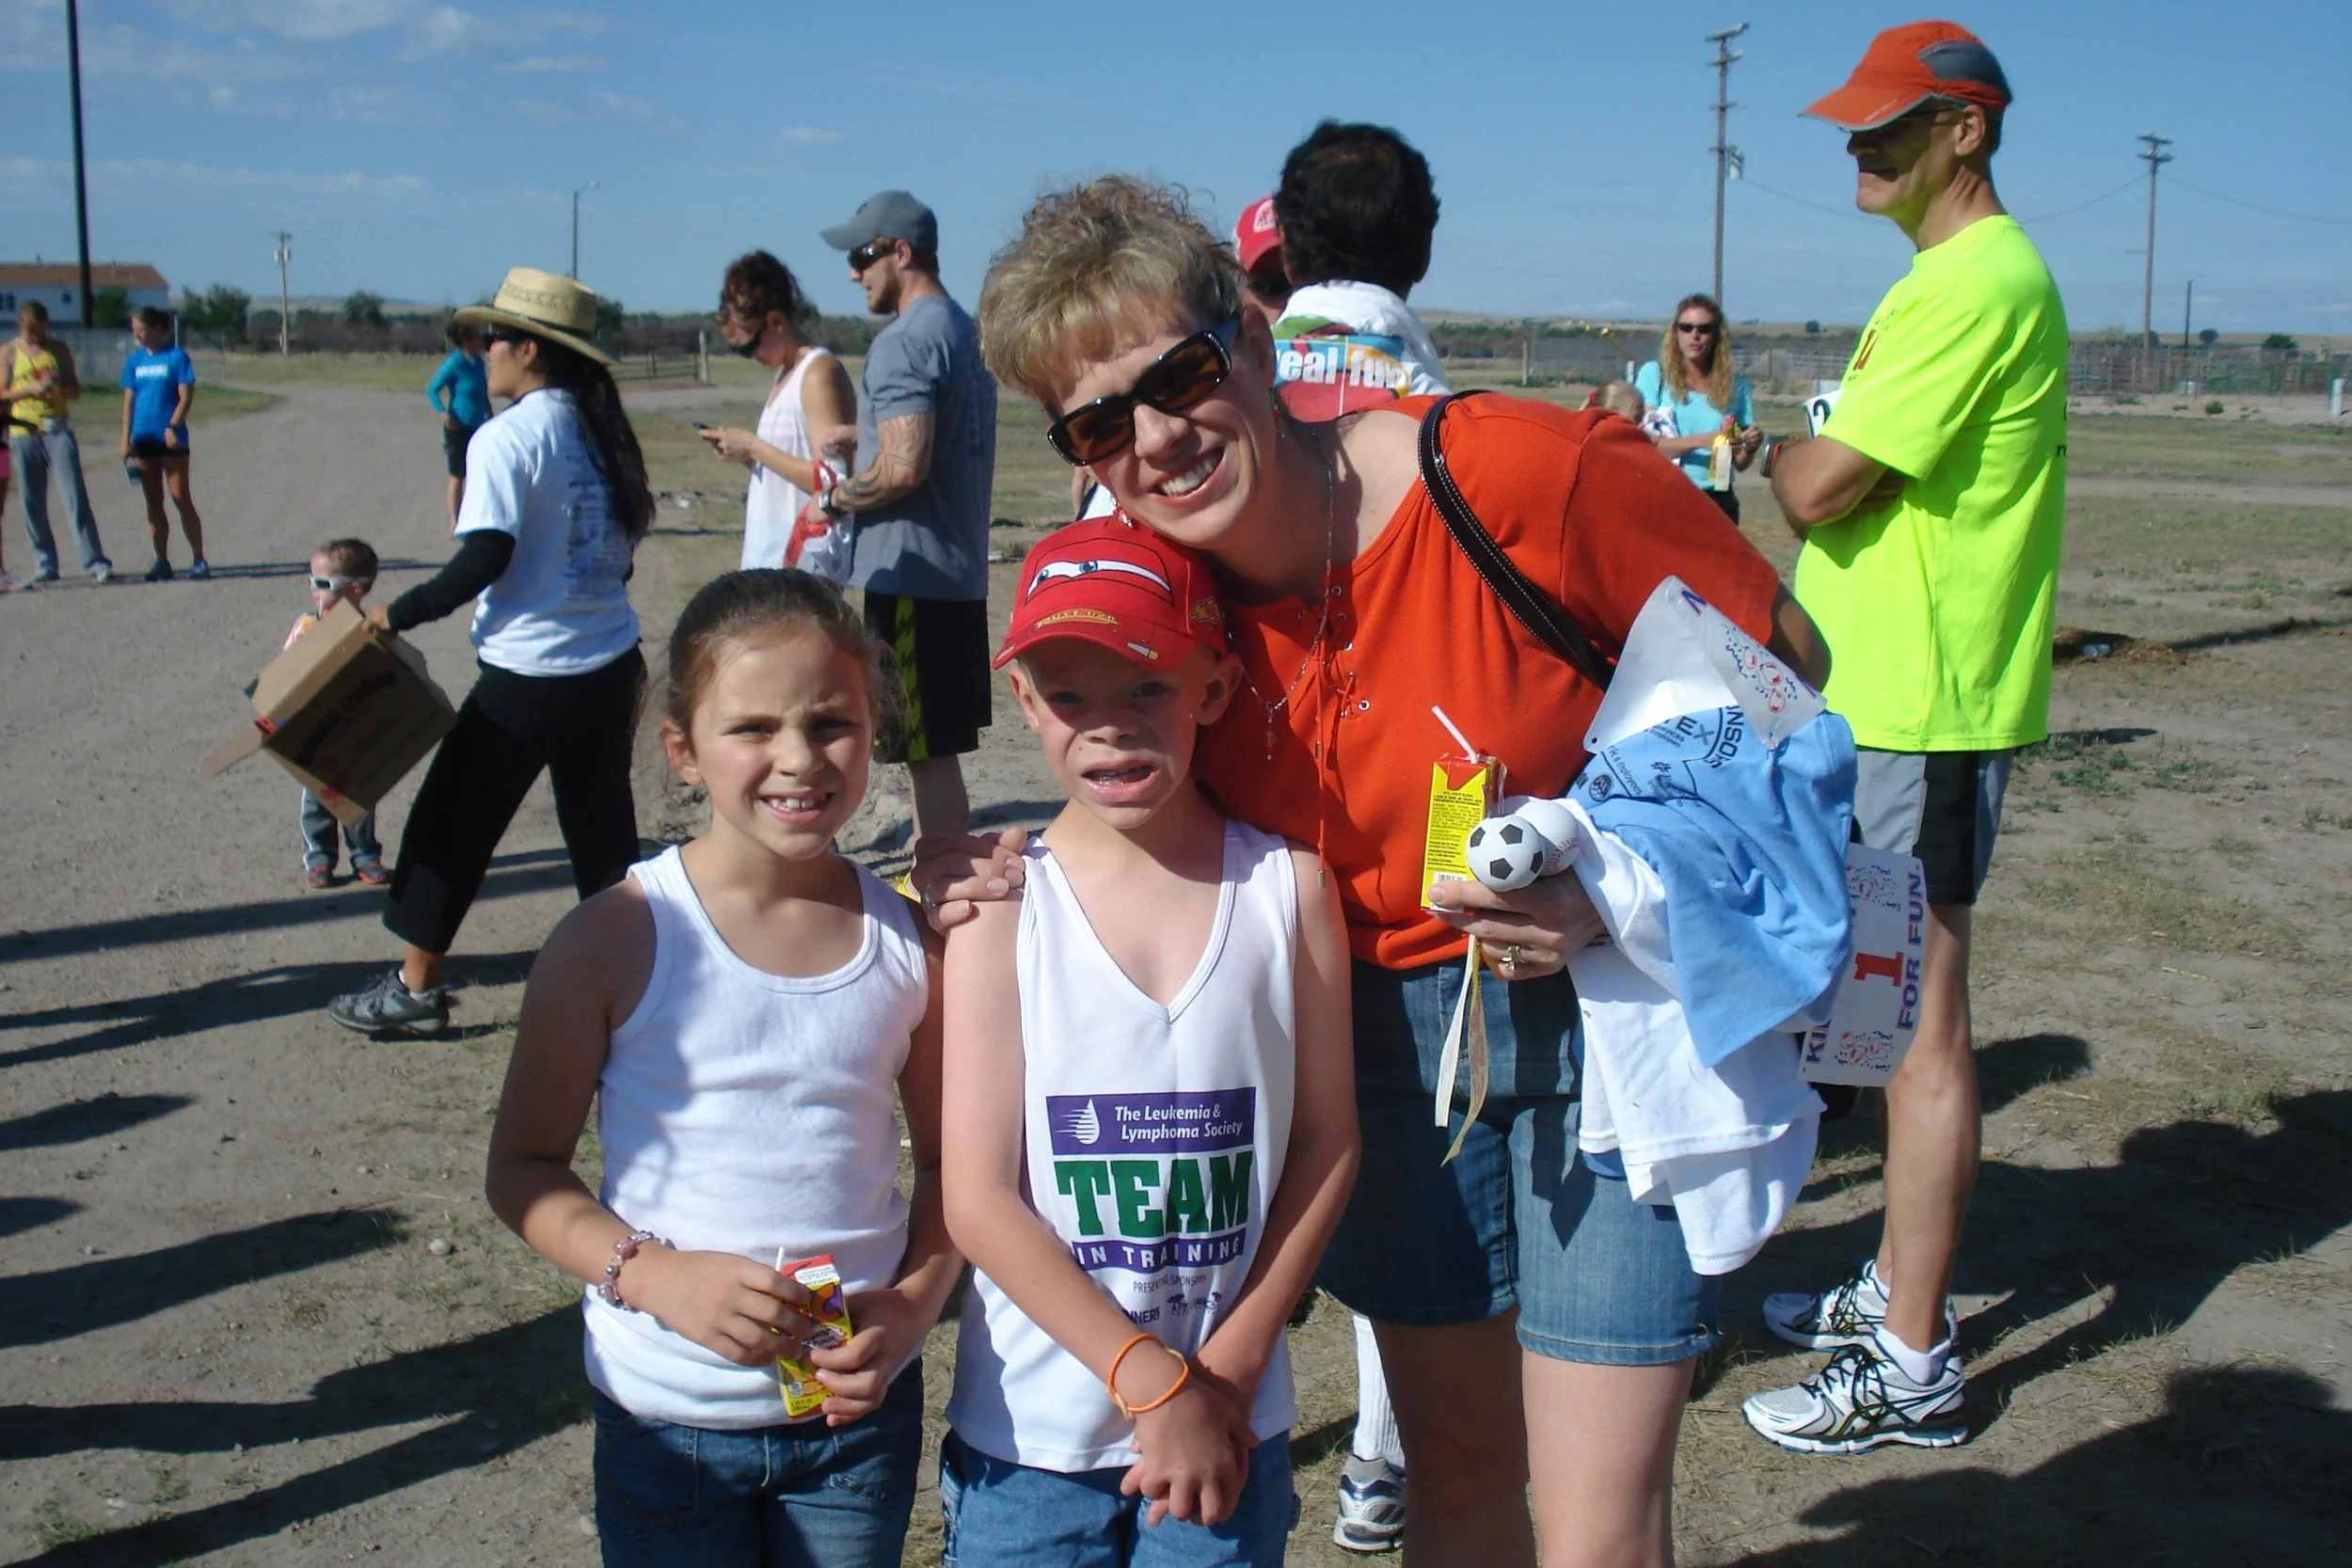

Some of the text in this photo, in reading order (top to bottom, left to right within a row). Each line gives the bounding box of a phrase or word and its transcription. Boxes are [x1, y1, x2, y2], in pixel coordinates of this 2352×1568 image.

[1349, 348, 1407, 388] fun
[1897, 870, 1924, 1031] FOR FUN
[1854, 952, 1904, 987] 1
[1115, 1103, 1221, 1122] The Leukemia &
[1121, 1120, 1243, 1143] Lymphoma Society
[1054, 1150, 1254, 1238] TEAM
[1076, 1236, 1239, 1268] IN TRAINING
